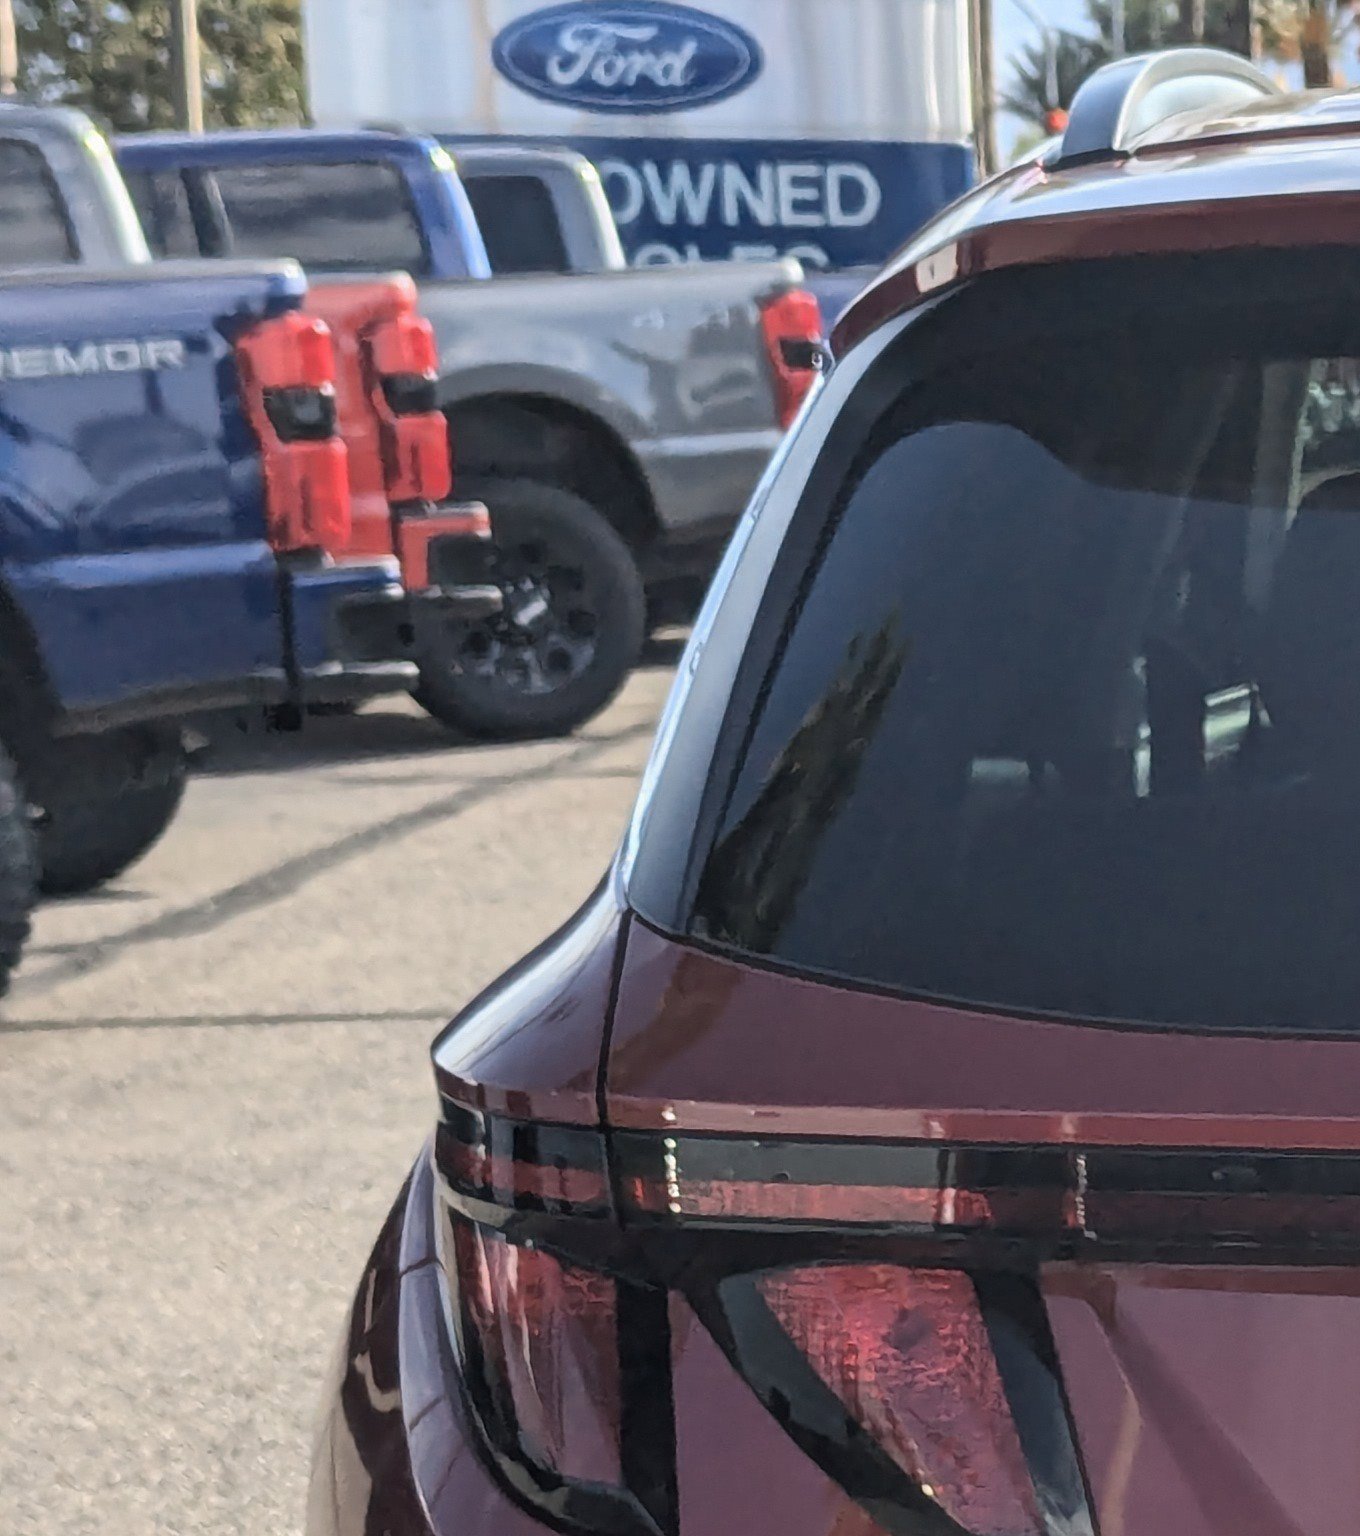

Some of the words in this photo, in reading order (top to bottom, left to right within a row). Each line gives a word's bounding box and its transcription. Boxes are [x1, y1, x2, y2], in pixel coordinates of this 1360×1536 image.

[546, 22, 698, 87] Ford
[600, 160, 882, 227] OWNED
[0, 338, 185, 379] EMOR
